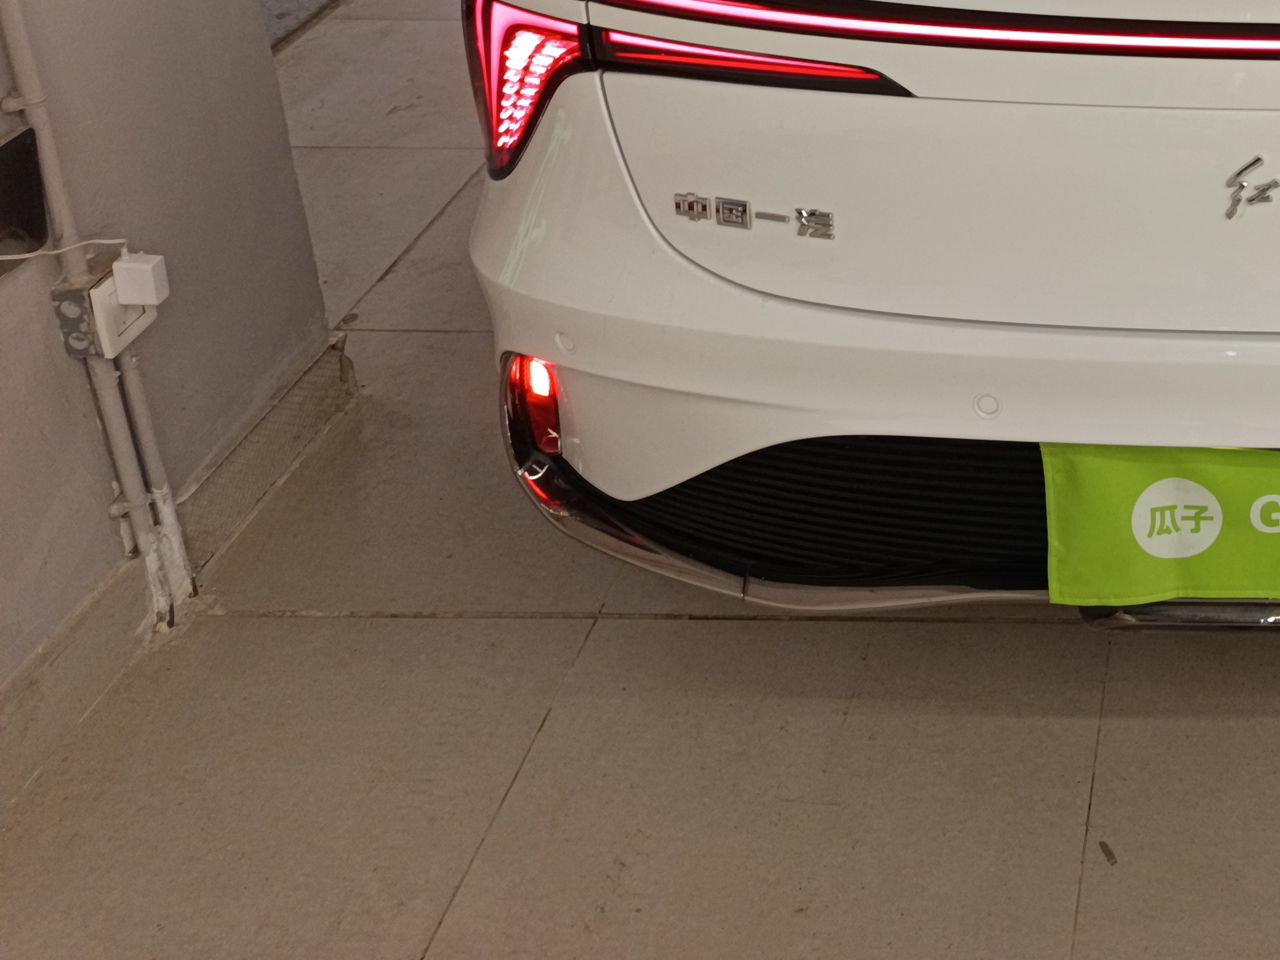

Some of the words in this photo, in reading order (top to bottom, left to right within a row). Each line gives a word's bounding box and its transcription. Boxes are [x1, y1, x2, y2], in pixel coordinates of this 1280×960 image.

[674, 192, 835, 240] 中国一汽
[1147, 504, 1214, 538] 瓜子
